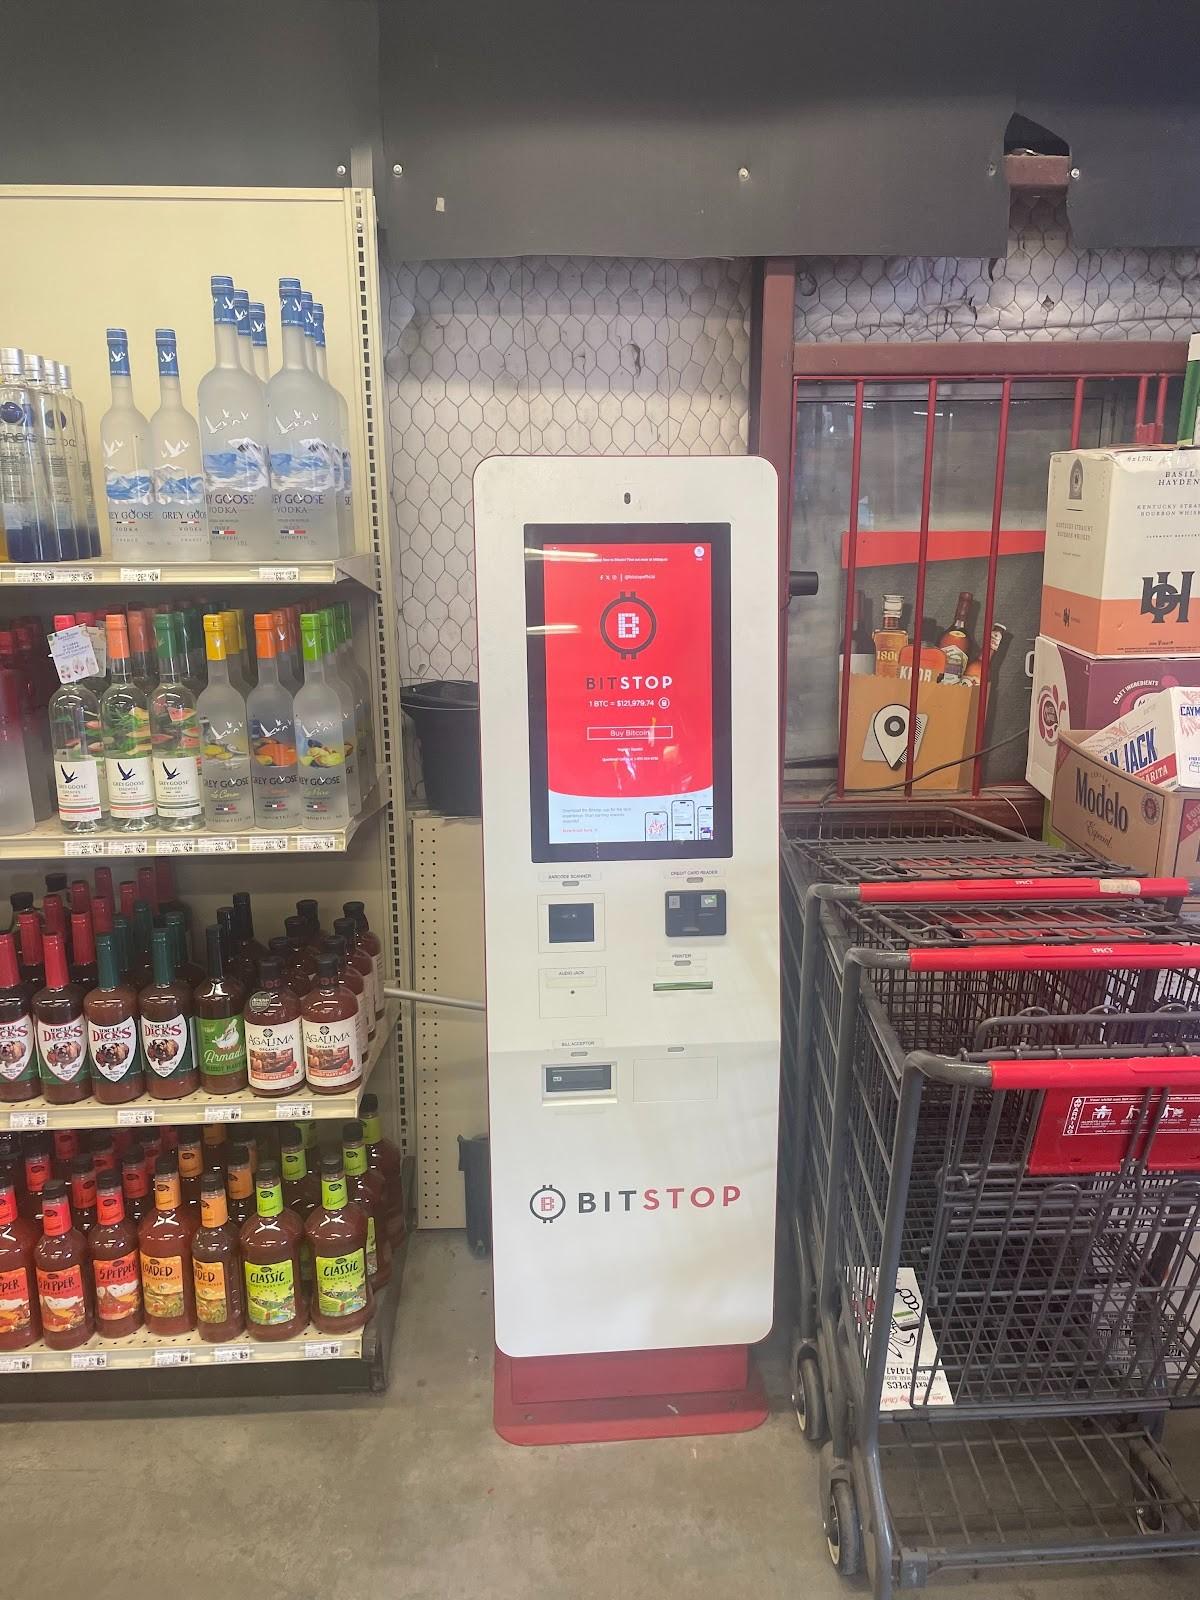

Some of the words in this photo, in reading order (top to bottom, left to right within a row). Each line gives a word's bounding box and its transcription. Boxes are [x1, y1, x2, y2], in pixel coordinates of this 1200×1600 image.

[1165, 470, 1195, 478] BASIL
[215, 494, 255, 505] GOOSE
[285, 493, 325, 504] GOOSE
[121, 510, 153, 520] GOOSE
[162, 511, 184, 520] GREY
[277, 506, 308, 514] VODKA
[586, 675, 673, 690] BITSTOP
[1113, 688, 1126, 705] CRAFT
[1125, 680, 1159, 692] INGREDIENTS
[610, 730, 625, 738] Buy
[625, 729, 650, 737] Bitcoin
[1124, 727, 1158, 774] JACK
[220, 778, 249, 788] GOOSE
[269, 775, 297, 785] GOOSE
[310, 776, 340, 786] GOOSE
[1075, 767, 1128, 833] Modelo
[1087, 820, 1112, 849] Especial
[43, 1026, 83, 1041] DICK'S
[92, 1027, 131, 1041] DICK'S
[144, 1024, 182, 1037] DICK'S
[248, 1034, 294, 1046] AGALIMA
[305, 1031, 350, 1044] AGALIMA
[1066, 1101, 1083, 1134] WARNING
[578, 1186, 741, 1213] BITSTOP
[100, 1269, 106, 1280] 5
[107, 1261, 136, 1279] PEPPER
[142, 1265, 173, 1277] LOADED
[323, 1260, 358, 1276] CLASSIC
[250, 1270, 285, 1283] CLASSIC
[43, 1276, 75, 1291] PEPPER
